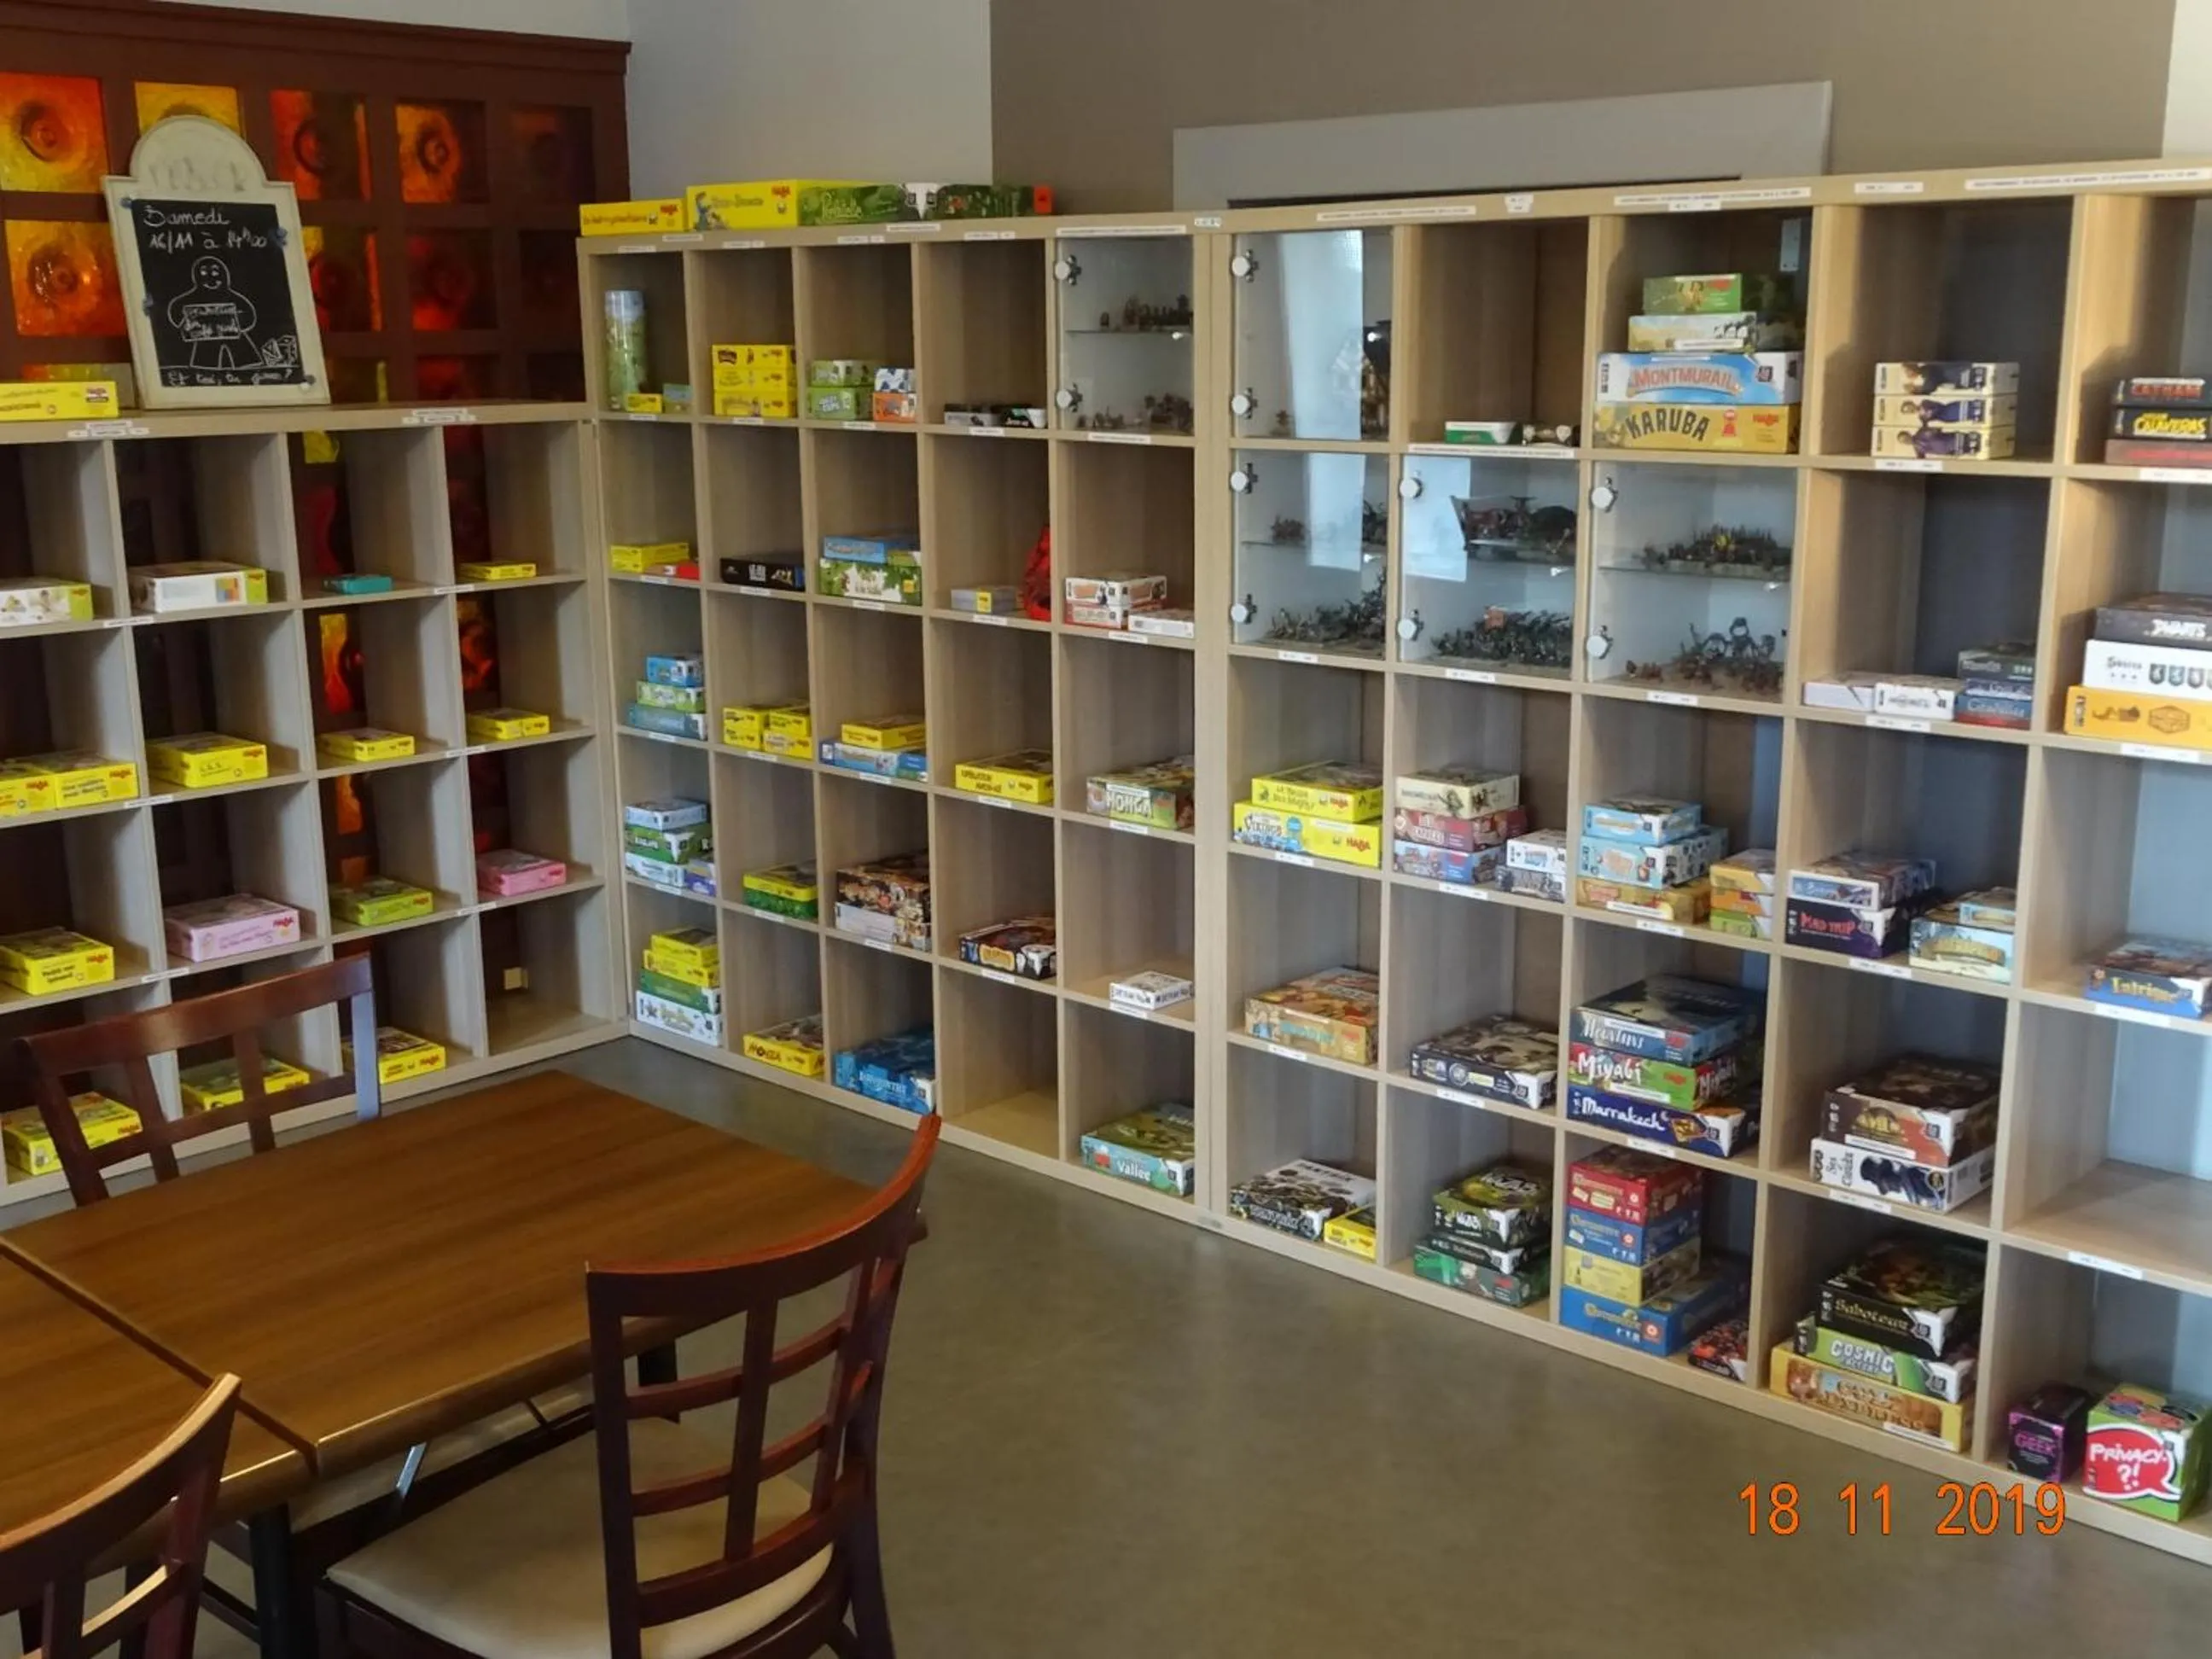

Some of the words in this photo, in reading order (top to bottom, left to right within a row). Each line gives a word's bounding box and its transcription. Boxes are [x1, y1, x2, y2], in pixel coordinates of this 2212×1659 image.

[143, 205, 230, 227] Samedi
[1633, 366, 1735, 387] MONTMURAIL
[1625, 408, 1710, 442] KARUBA
[1346, 837, 1371, 853] HABA
[1578, 1051, 1642, 1086] Miyabi
[1582, 1096, 1666, 1132] Marrakech
[1835, 1298, 1909, 1330] Saboteur
[1831, 1338, 1895, 1374] COSMIC
